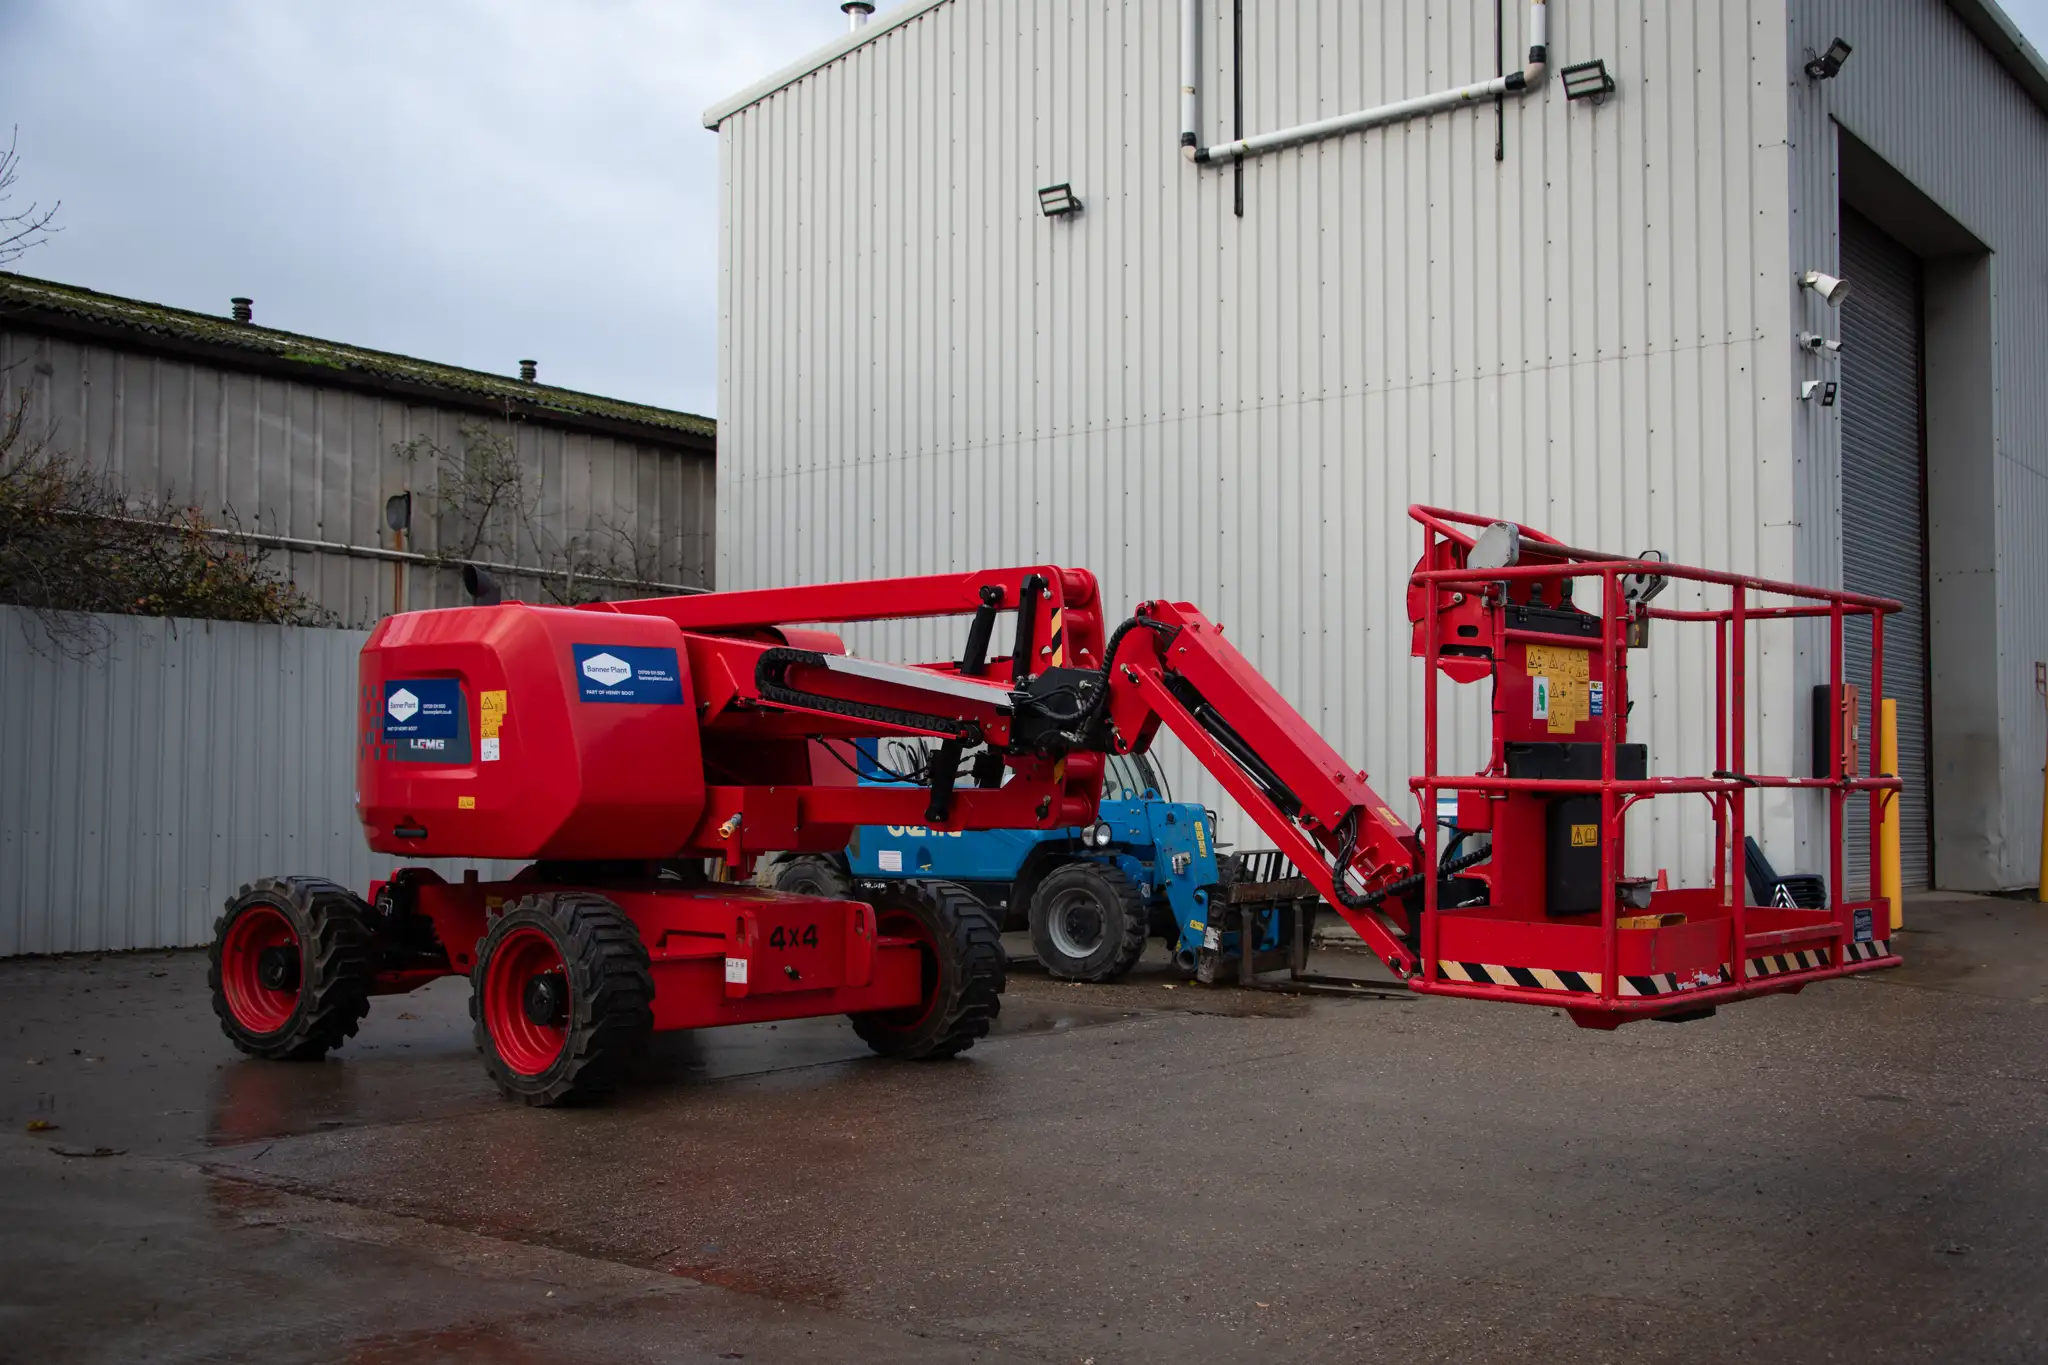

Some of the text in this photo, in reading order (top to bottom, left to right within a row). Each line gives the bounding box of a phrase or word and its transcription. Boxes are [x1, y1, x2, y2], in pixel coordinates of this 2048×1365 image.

[586, 665, 628, 674] Banner Plant
[390, 701, 404, 709] Banner
[404, 701, 416, 709] Plant
[410, 738, 445, 750] LGMG
